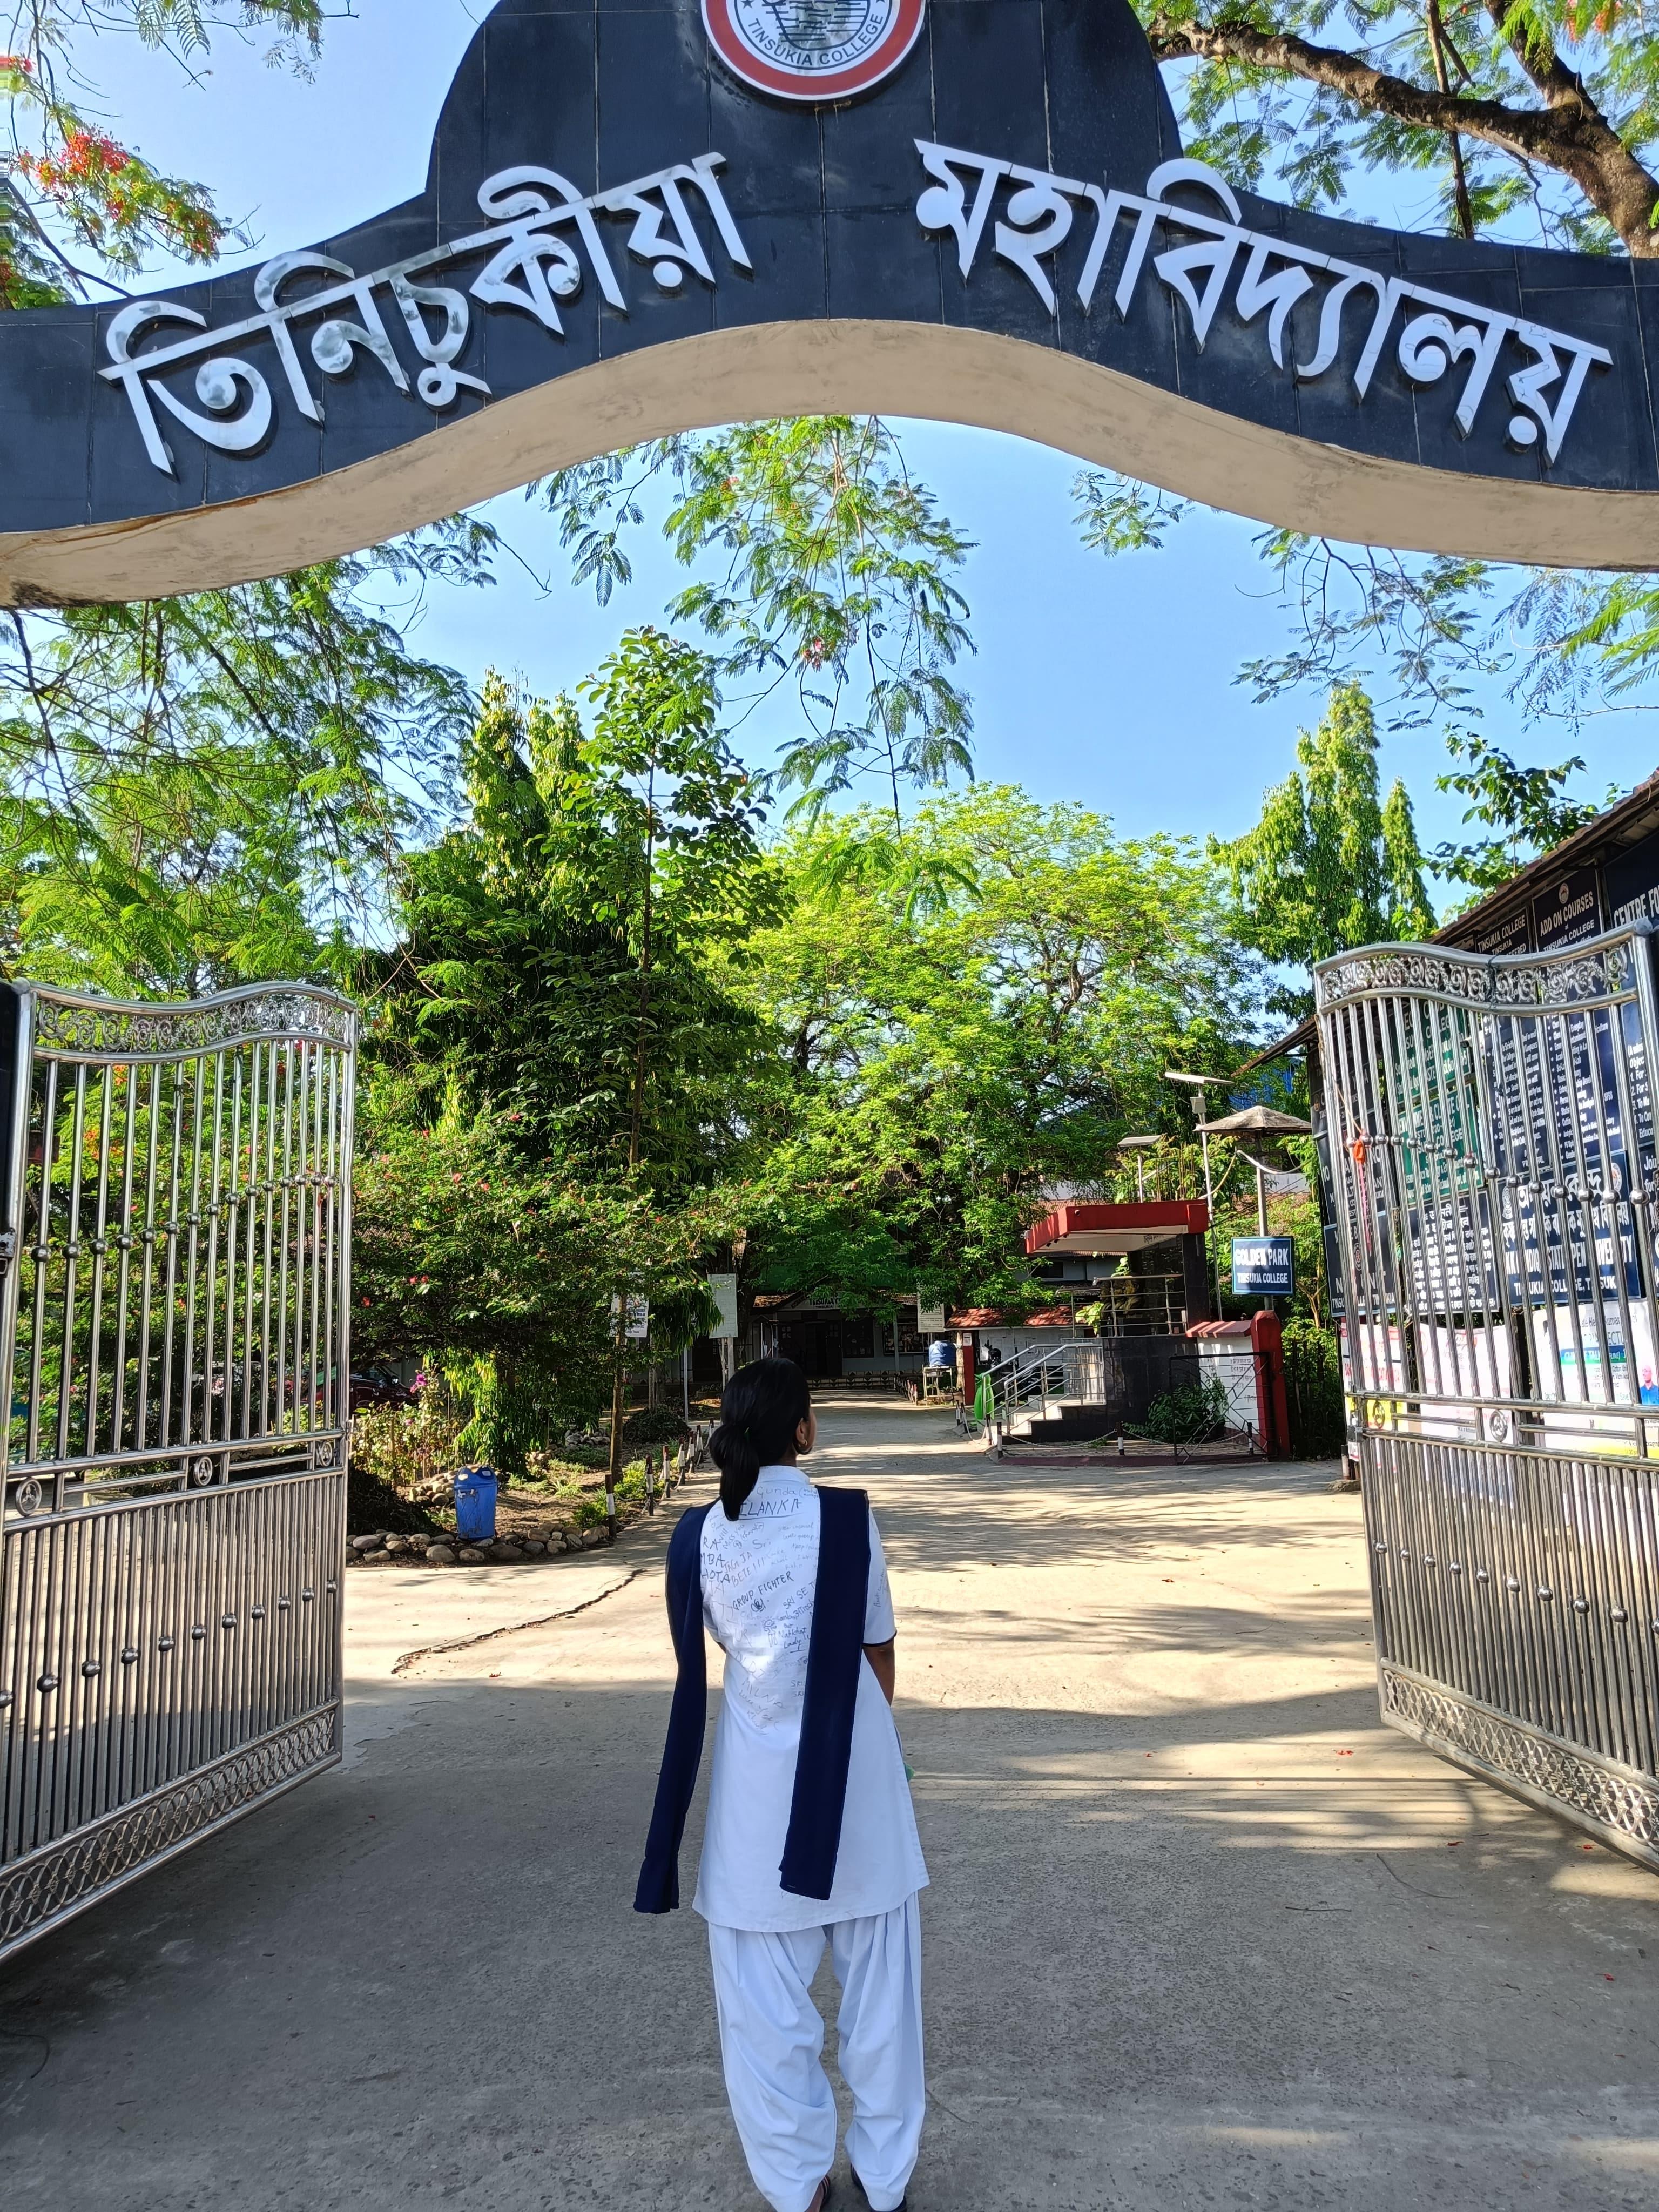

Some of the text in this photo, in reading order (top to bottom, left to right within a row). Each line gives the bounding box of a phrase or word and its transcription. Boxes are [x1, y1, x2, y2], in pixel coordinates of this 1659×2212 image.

[747, 14, 884, 65] TINSUKIA COLLEGE
[97, 138, 1616, 480] তিনিচুকীয়া মহাবিদ্যালয়
[1540, 891, 1594, 938] ADD ON COURSES
[1648, 885, 1659, 918] FO
[1478, 914, 1526, 953] TINSUKIA COLLEGE
[1569, 919, 1595, 940] COLLEGE
[1235, 1247, 1289, 1266] GOLDEN PARK
[1237, 1272, 1289, 1284] TINSUKIA COLLEGE
[732, 1570, 794, 1610] GROUP FIGHTER
